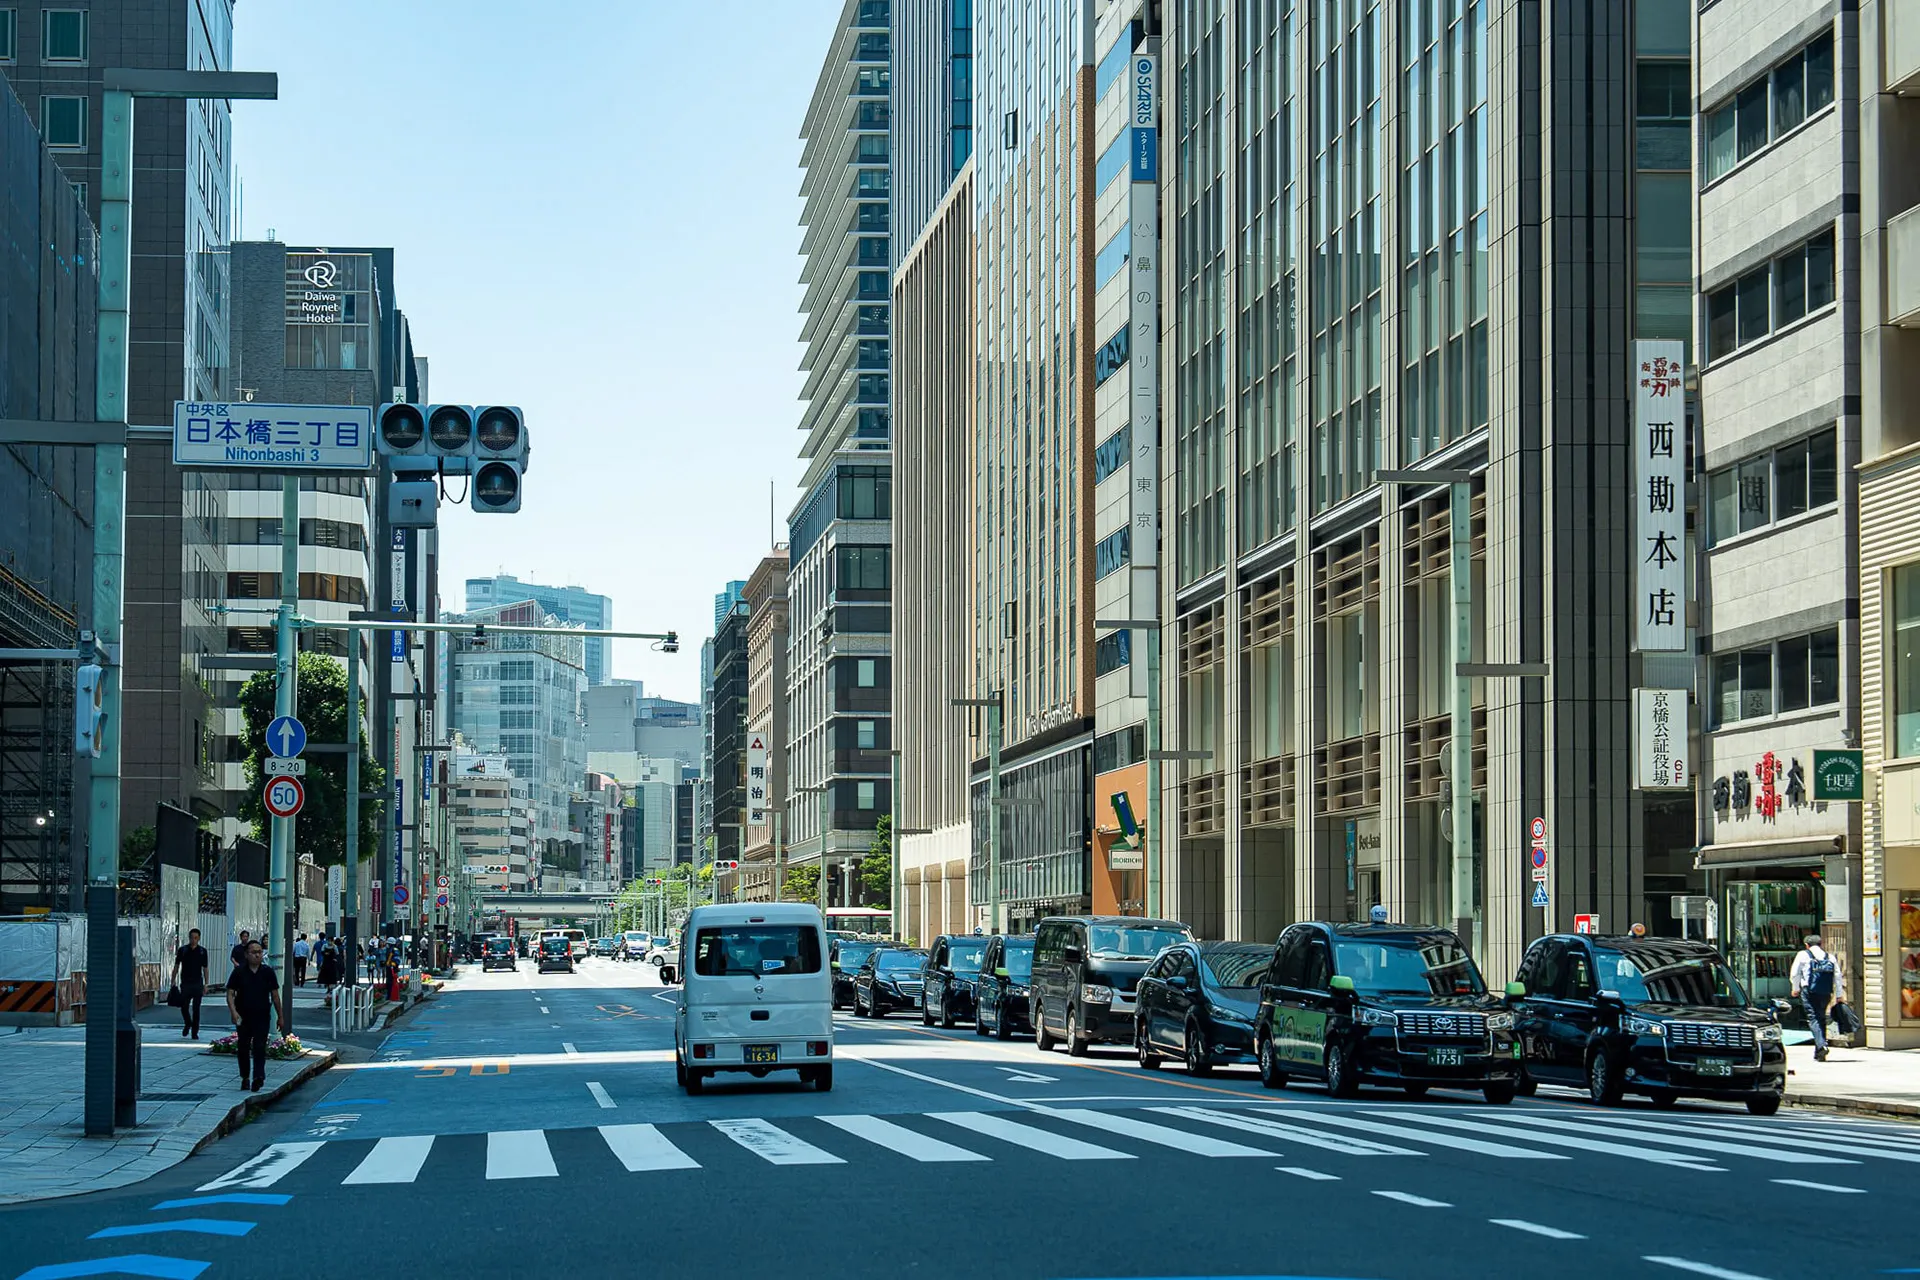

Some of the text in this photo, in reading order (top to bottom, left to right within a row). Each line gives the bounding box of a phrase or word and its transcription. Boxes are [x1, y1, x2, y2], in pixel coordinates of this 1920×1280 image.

[305, 292, 336, 301] Daiwa
[302, 302, 338, 314] Roynet
[306, 313, 334, 323] Hotel
[1135, 256, 1153, 529] 鼻のクリニック東京
[186, 403, 230, 417] 中央区
[187, 418, 359, 447] 日本橋三丁目
[225, 446, 320, 462] Nihonbashi 3
[1644, 421, 1678, 627] 西勘本店
[1652, 692, 1670, 786] 京橋公証役場
[1674, 759, 1683, 784] 6F
[273, 786, 296, 806] 50
[751, 1051, 776, 1062] 16-34
[1436, 1054, 1461, 1065] 17-51
